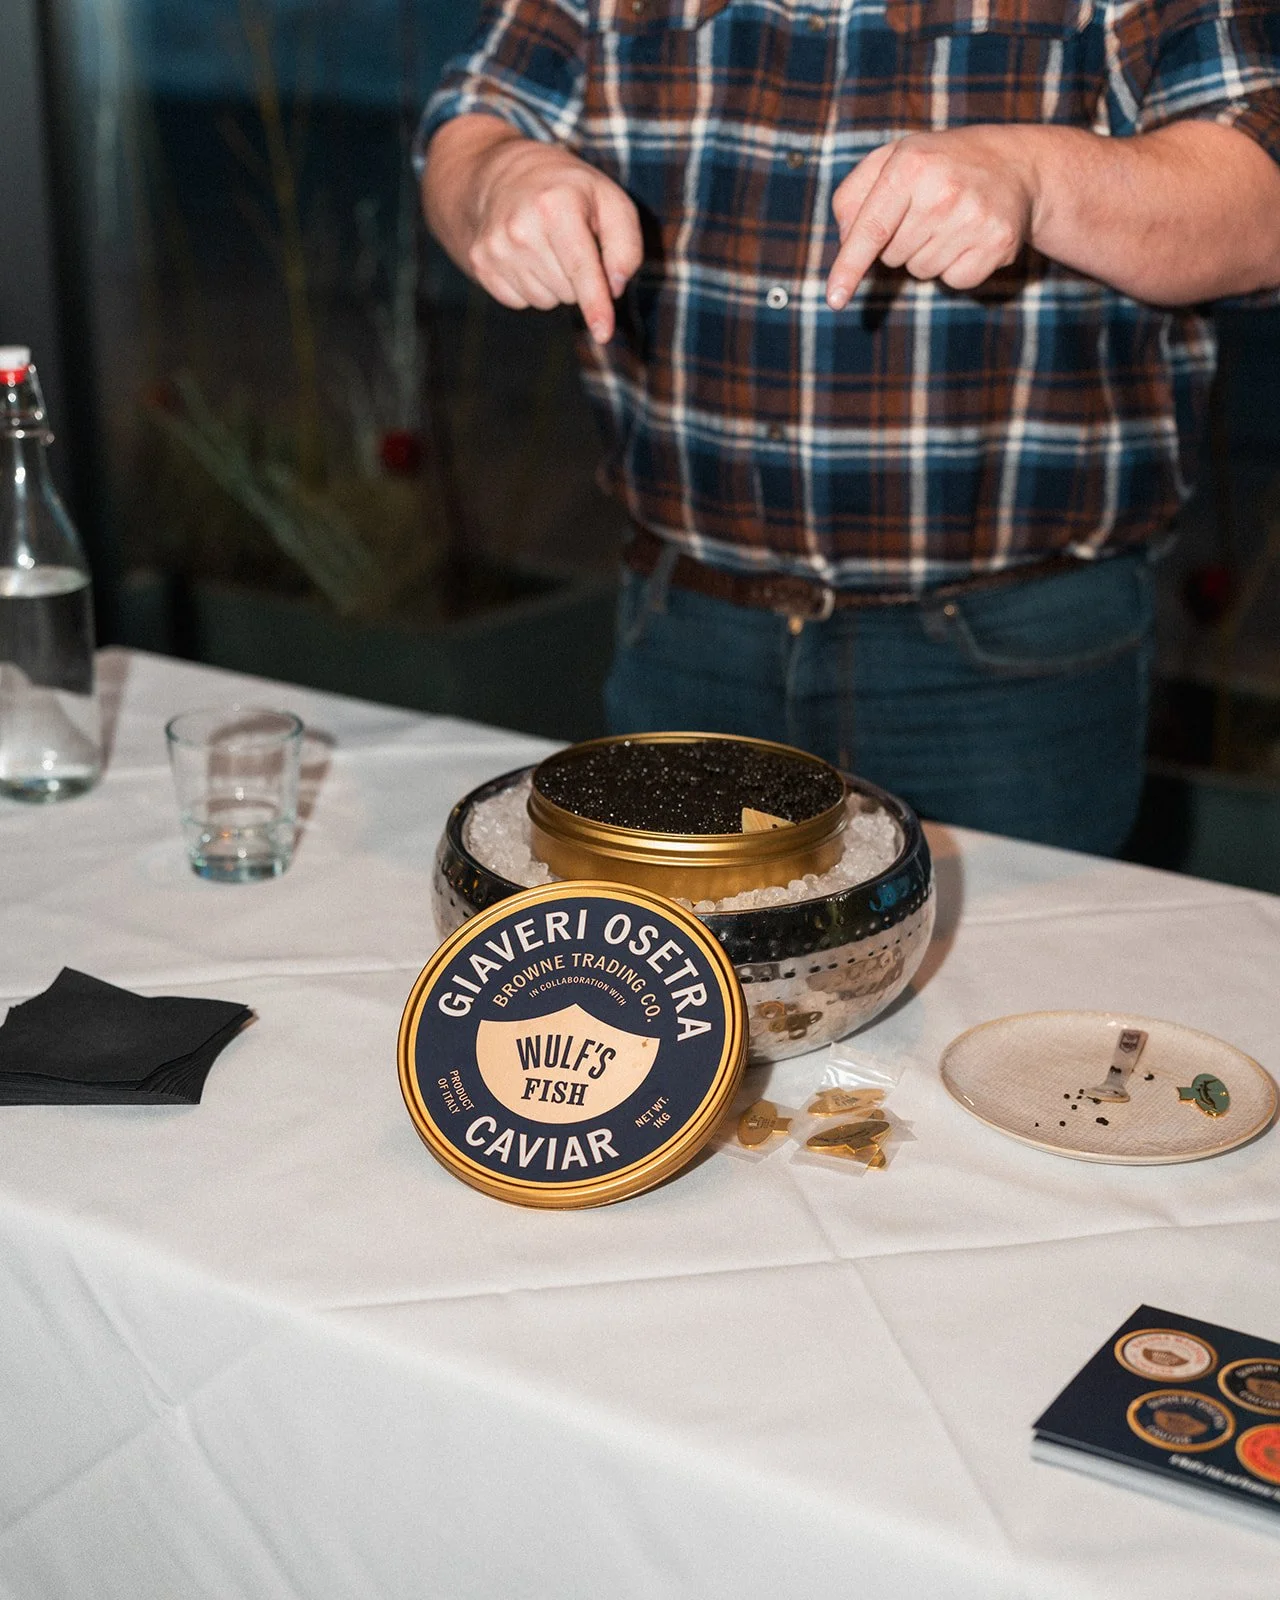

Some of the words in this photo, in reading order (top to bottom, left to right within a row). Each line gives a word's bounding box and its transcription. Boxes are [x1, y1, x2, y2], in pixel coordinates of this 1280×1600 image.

[438, 909, 588, 1018] GIAVERI
[604, 913, 712, 1042] OSETRA
[493, 955, 565, 1008] BROWNE
[572, 953, 645, 993] TRADING
[640, 989, 662, 1023] CO.
[529, 988, 538, 998] IN
[540, 977, 609, 991] COLLABORATION
[608, 988, 627, 1006] WITH
[516, 1034, 617, 1079] WULF'S
[437, 1078, 448, 1094] OF
[443, 1090, 461, 1115] ITALY
[450, 1069, 474, 1111] PRODUCT
[521, 1078, 589, 1106] FISH
[635, 1110, 654, 1128] NET
[648, 1096, 670, 1116] WT.
[652, 1112, 672, 1130] 1KG
[465, 1116, 620, 1171] CAVIAR
